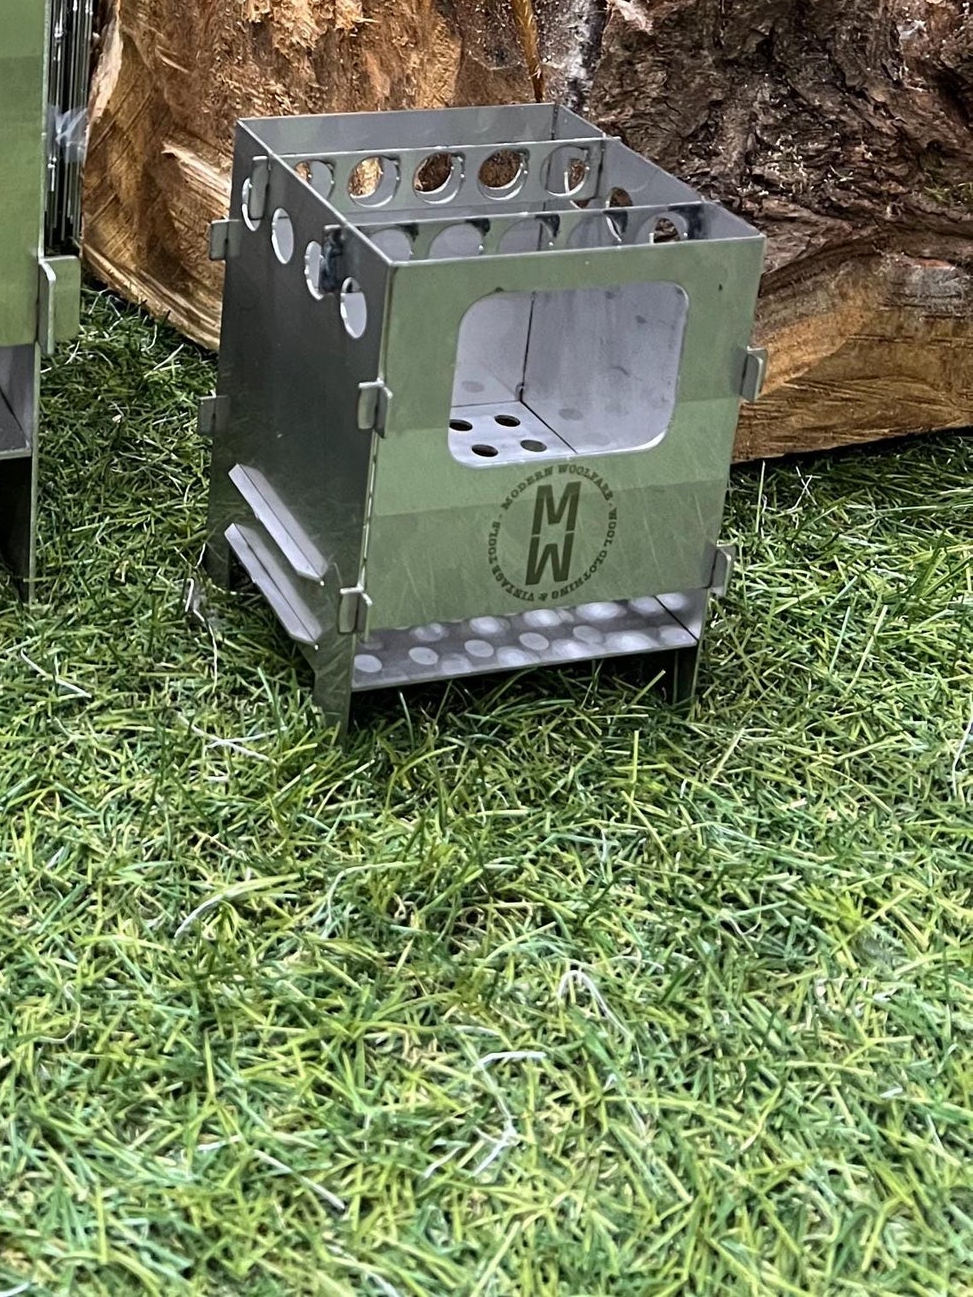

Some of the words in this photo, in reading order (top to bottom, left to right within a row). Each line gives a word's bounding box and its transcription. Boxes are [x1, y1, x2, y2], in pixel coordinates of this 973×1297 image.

[501, 466, 553, 510] MODERN
[558, 464, 614, 501] WOOLFARE
[532, 481, 582, 536] M
[604, 507, 618, 548] WOOL
[488, 520, 501, 564] TOOLS
[491, 564, 535, 602] VINTAGE
[551, 550, 608, 600] CLOTHING
